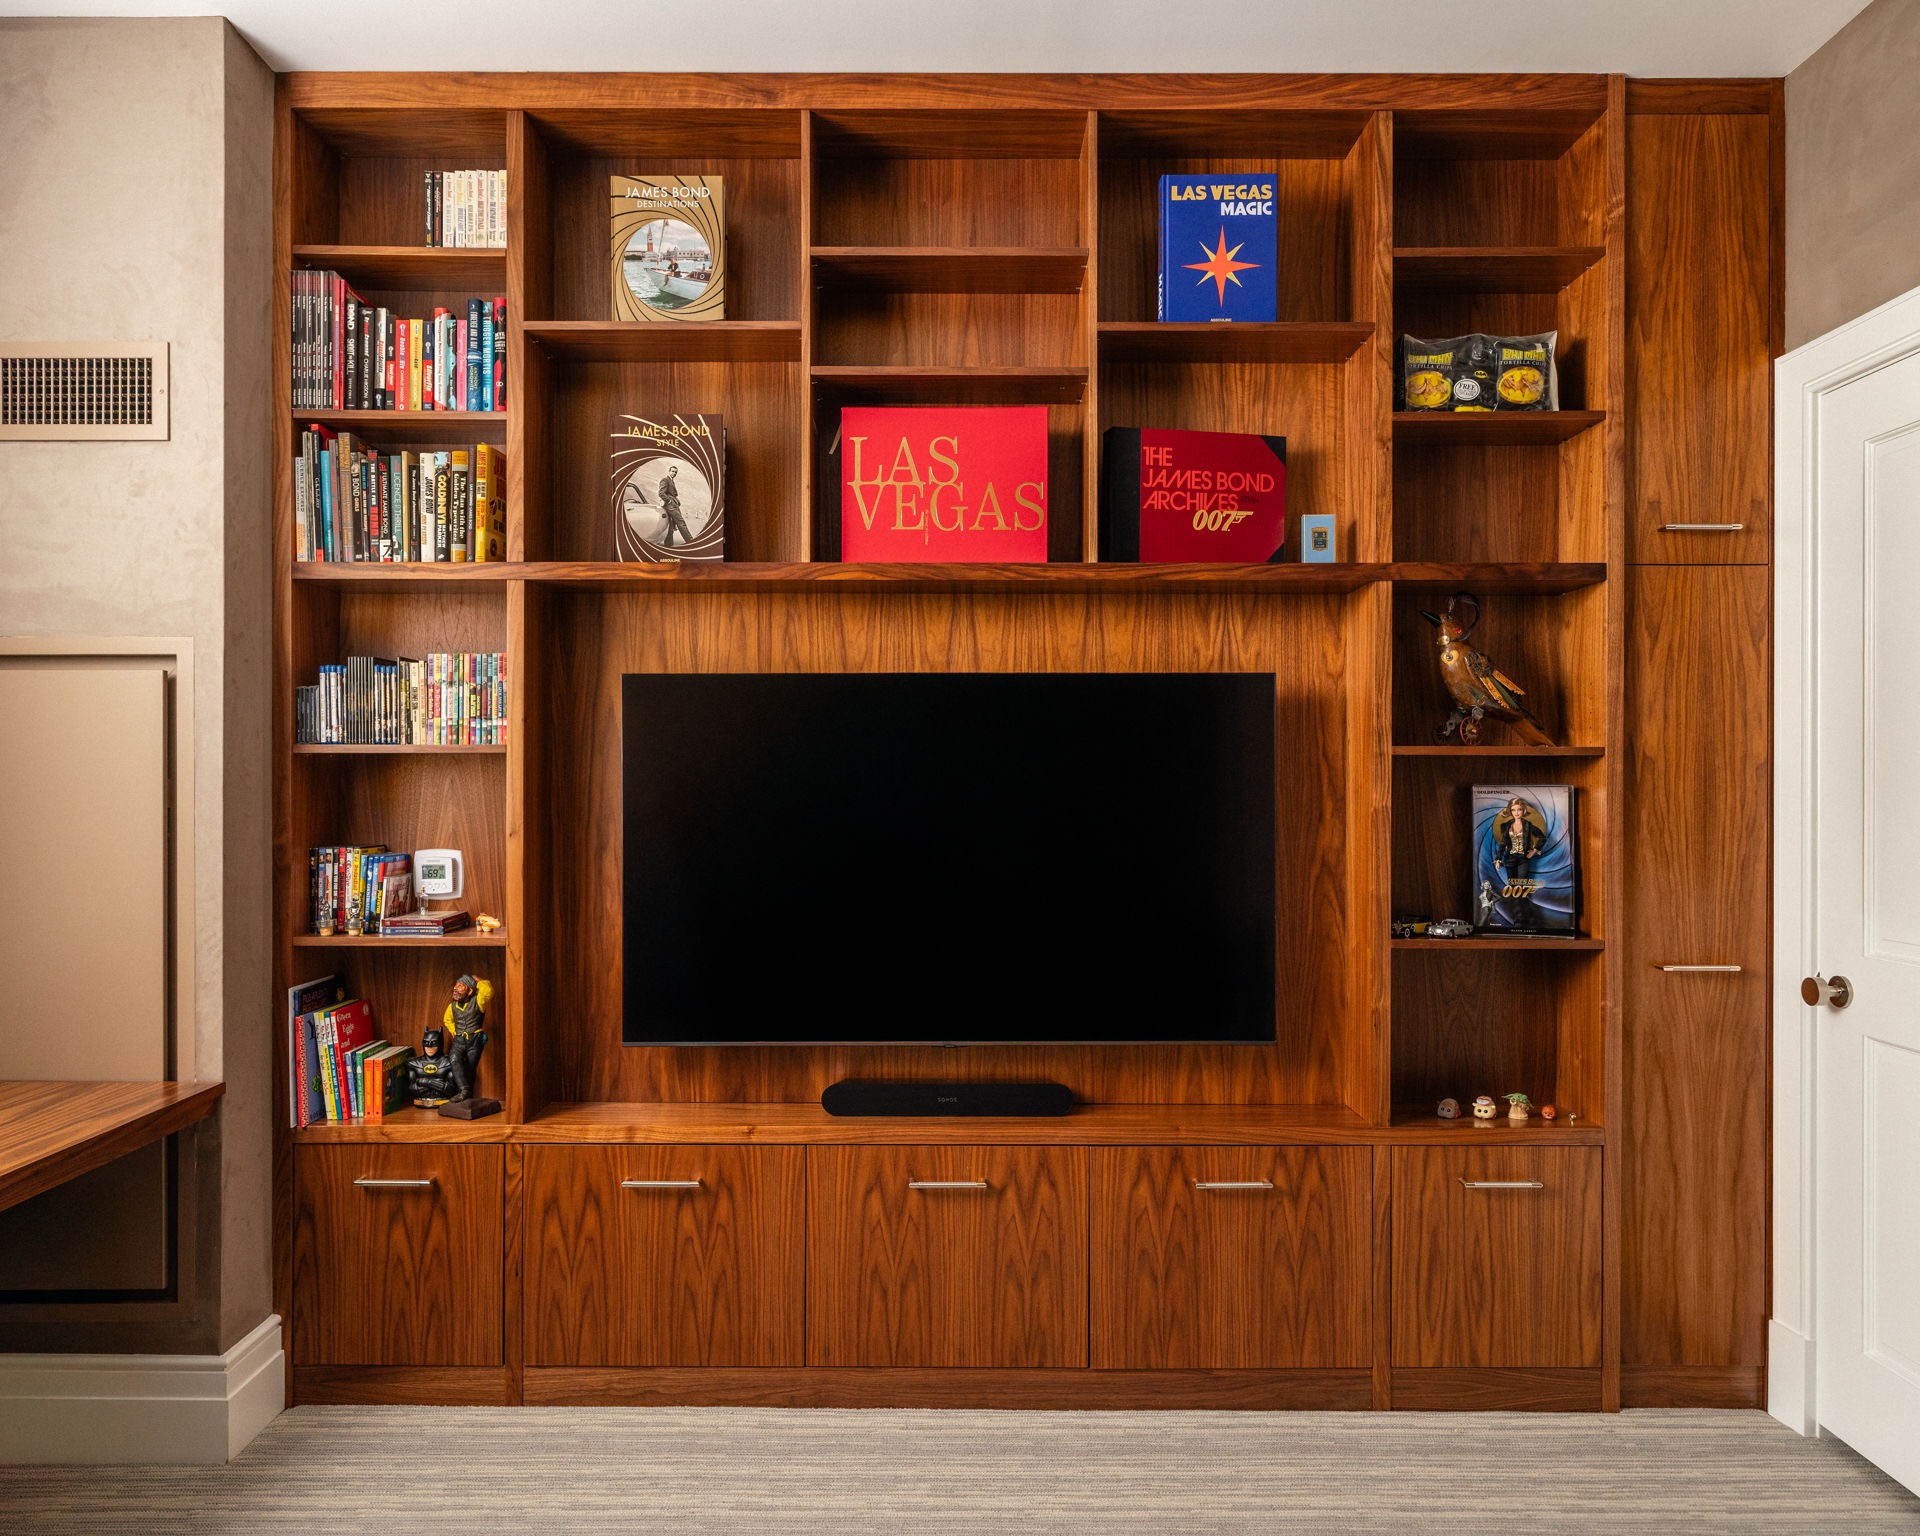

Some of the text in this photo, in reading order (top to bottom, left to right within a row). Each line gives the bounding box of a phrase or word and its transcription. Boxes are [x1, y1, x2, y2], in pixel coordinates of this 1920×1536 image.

[625, 187, 710, 198] JAMES BOND
[1171, 184, 1273, 200] LAS VEGAS
[637, 200, 699, 208] DESTINATIONS
[1220, 201, 1272, 216] MAGIC
[347, 304, 355, 330] BOND
[470, 312, 478, 328] FOREVER
[470, 329, 478, 338] AND
[347, 338, 355, 356] SHOOT
[470, 341, 478, 349] DAY
[483, 316, 492, 375] TRIGGER MORTIS
[1502, 348, 1545, 361] BATMAN
[347, 360, 355, 375] KILL
[627, 425, 710, 437] JAMES BOND
[656, 439, 679, 447] STYLE
[478, 451, 488, 466] JAMES
[848, 436, 959, 486] LAS
[1143, 446, 1173, 467] THE
[393, 472, 401, 503] LICENCE
[1142, 469, 1274, 493] JAMES BOND
[425, 476, 434, 515] JAMES BOND
[437, 475, 447, 525] GOLDENEYE
[1142, 490, 1238, 511] ARCHIVES
[847, 482, 1045, 532] VEGAS
[370, 507, 379, 536] BOND
[394, 510, 402, 533] THRILL
[1193, 510, 1246, 532] 007
[427, 869, 439, 878] 69
[1501, 885, 1536, 898] 007
[337, 1012, 352, 1022] Green
[342, 1022, 354, 1036] Eggs
